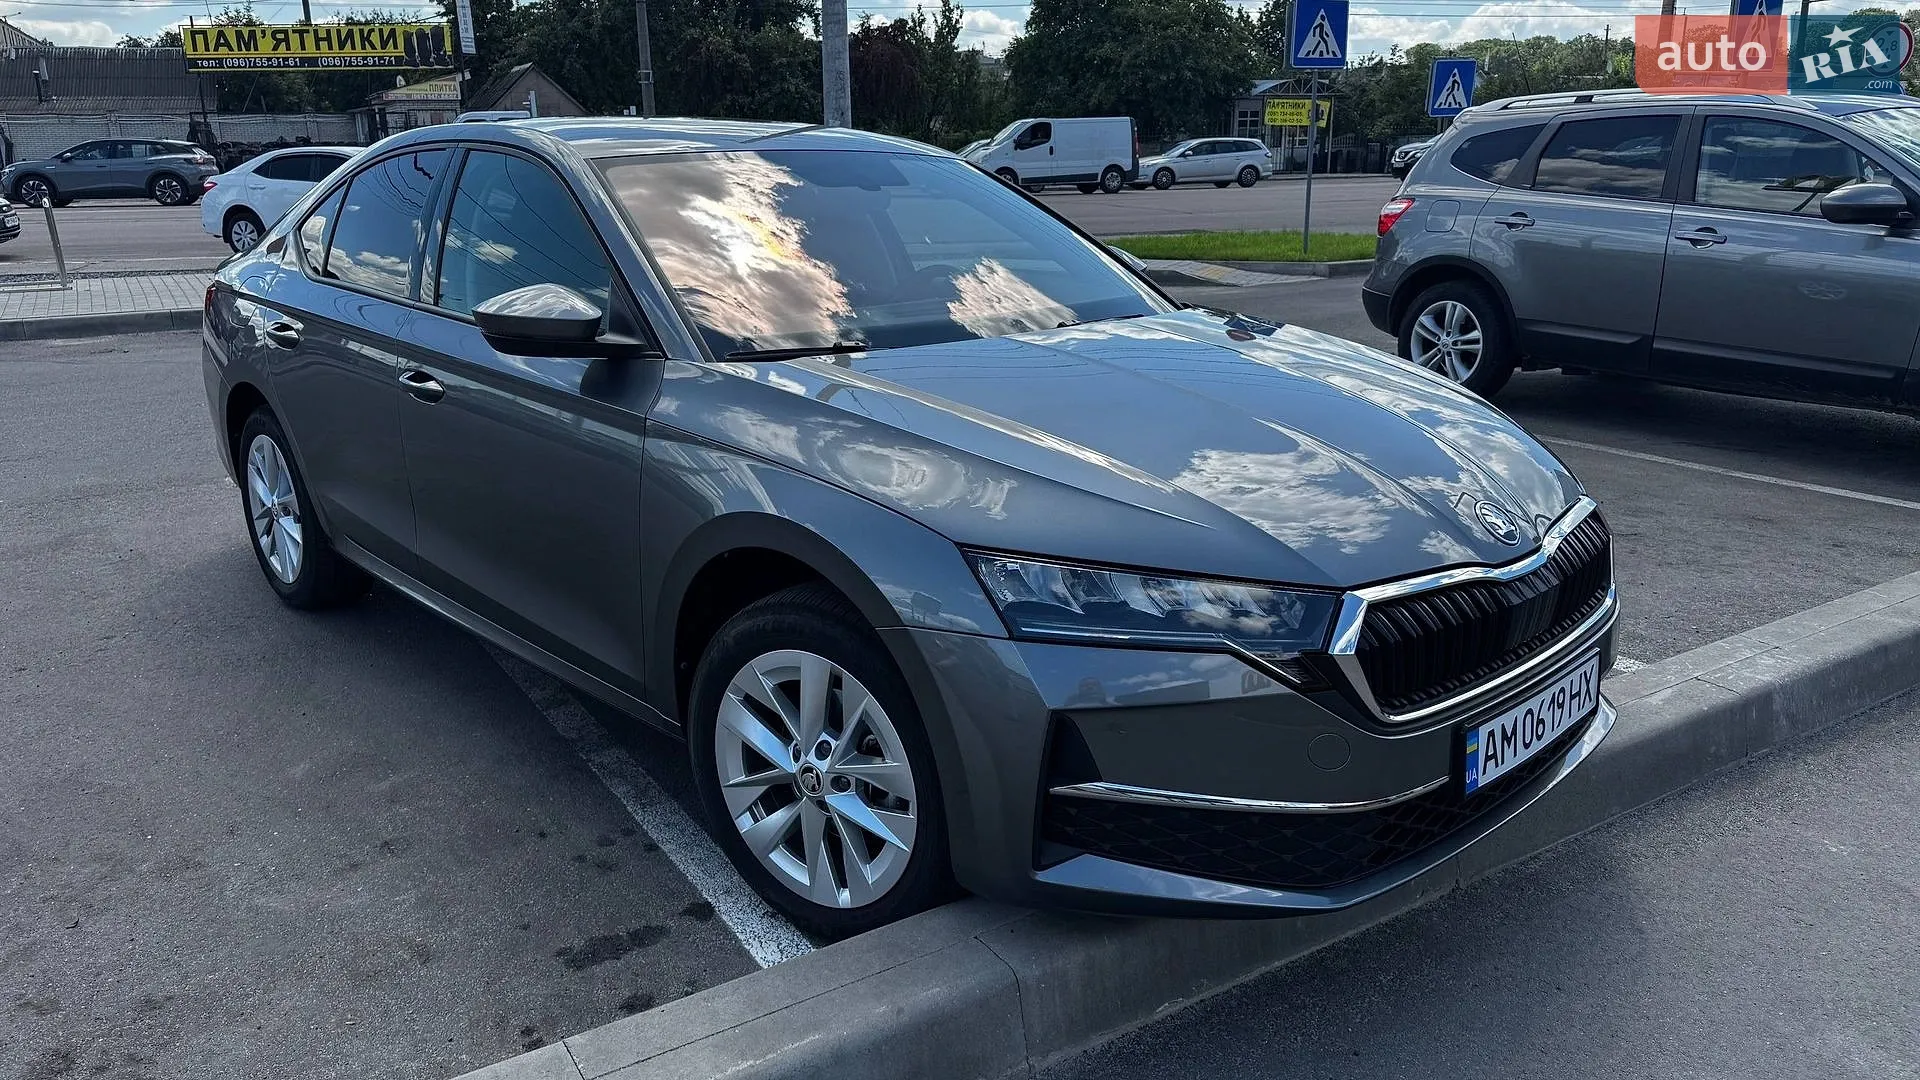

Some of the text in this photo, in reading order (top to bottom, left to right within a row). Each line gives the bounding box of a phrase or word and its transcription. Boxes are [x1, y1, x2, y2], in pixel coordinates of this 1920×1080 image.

[190, 28, 399, 53] ПАМ'ЯТНИКИ
[196, 60, 220, 68] тел:
[1466, 771, 1478, 784] UA
